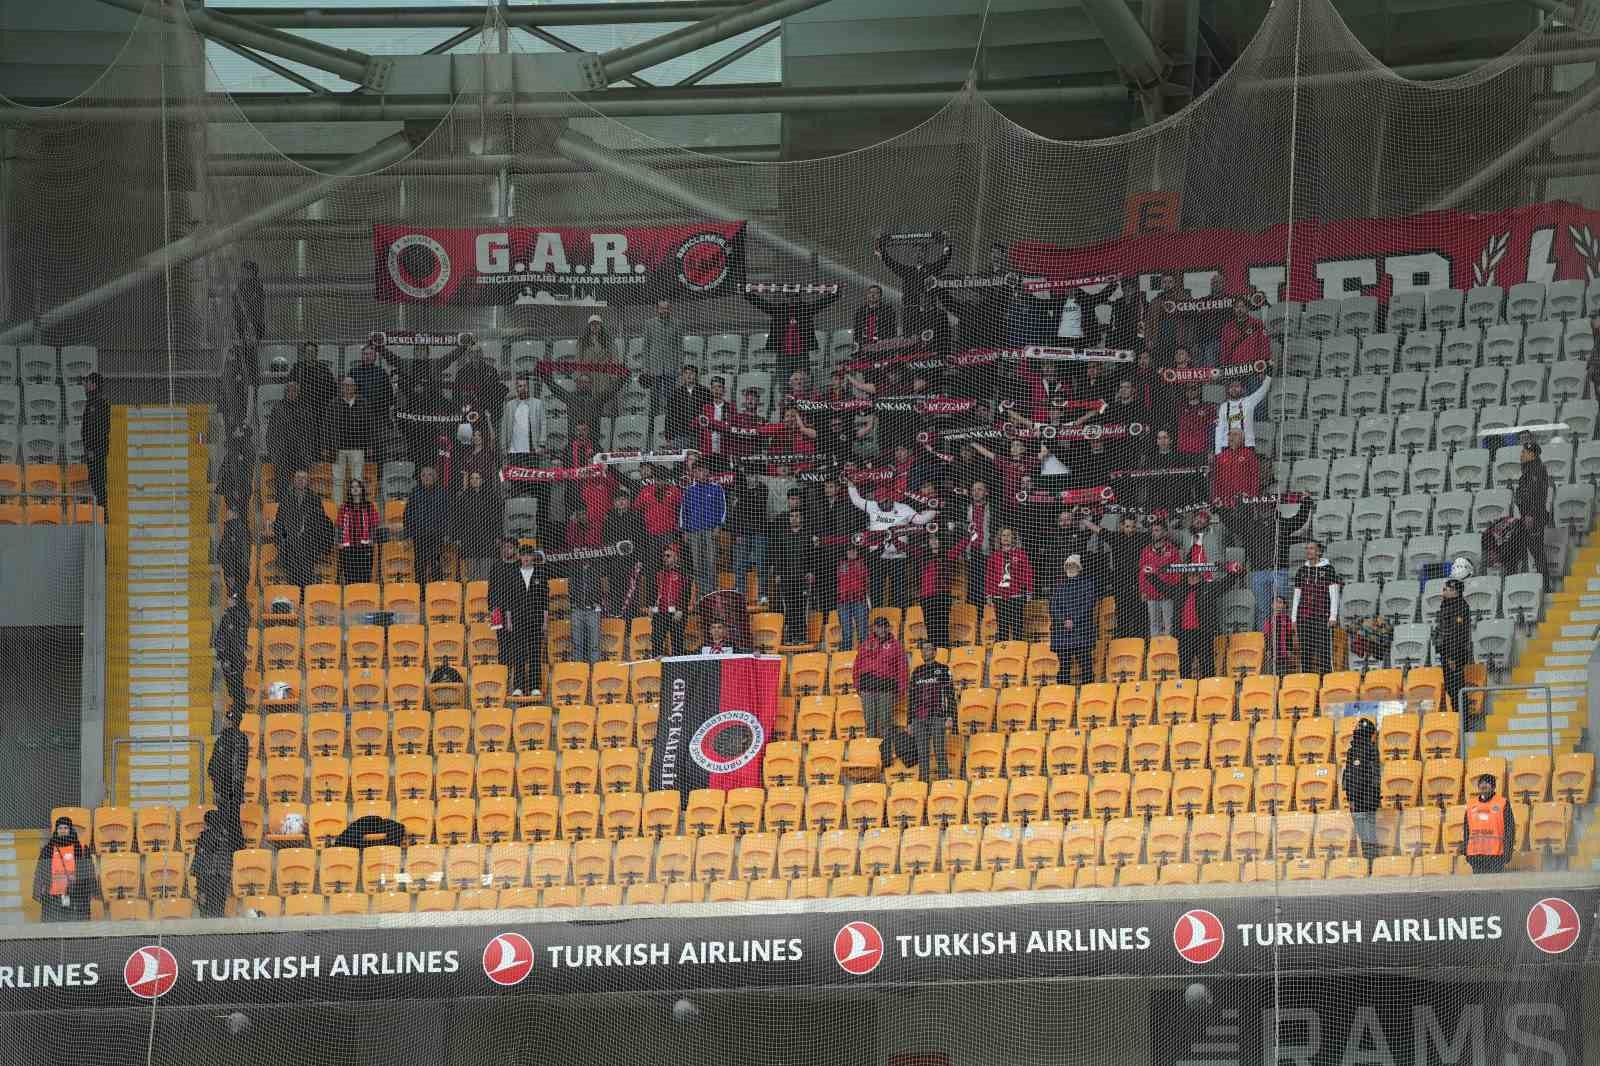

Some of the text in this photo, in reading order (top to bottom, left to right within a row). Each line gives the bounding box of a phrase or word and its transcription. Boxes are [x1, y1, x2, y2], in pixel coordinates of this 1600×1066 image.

[475, 232, 646, 274] G.A.R.
[668, 678, 686, 723] GENÇ
[896, 926, 1151, 956] TURKISH AIRLINES
[1238, 915, 1503, 947] TURKISH AIRLINES
[192, 949, 460, 983] TURKISH AIRLINES
[547, 938, 803, 967] TURKISH AIRLINES
